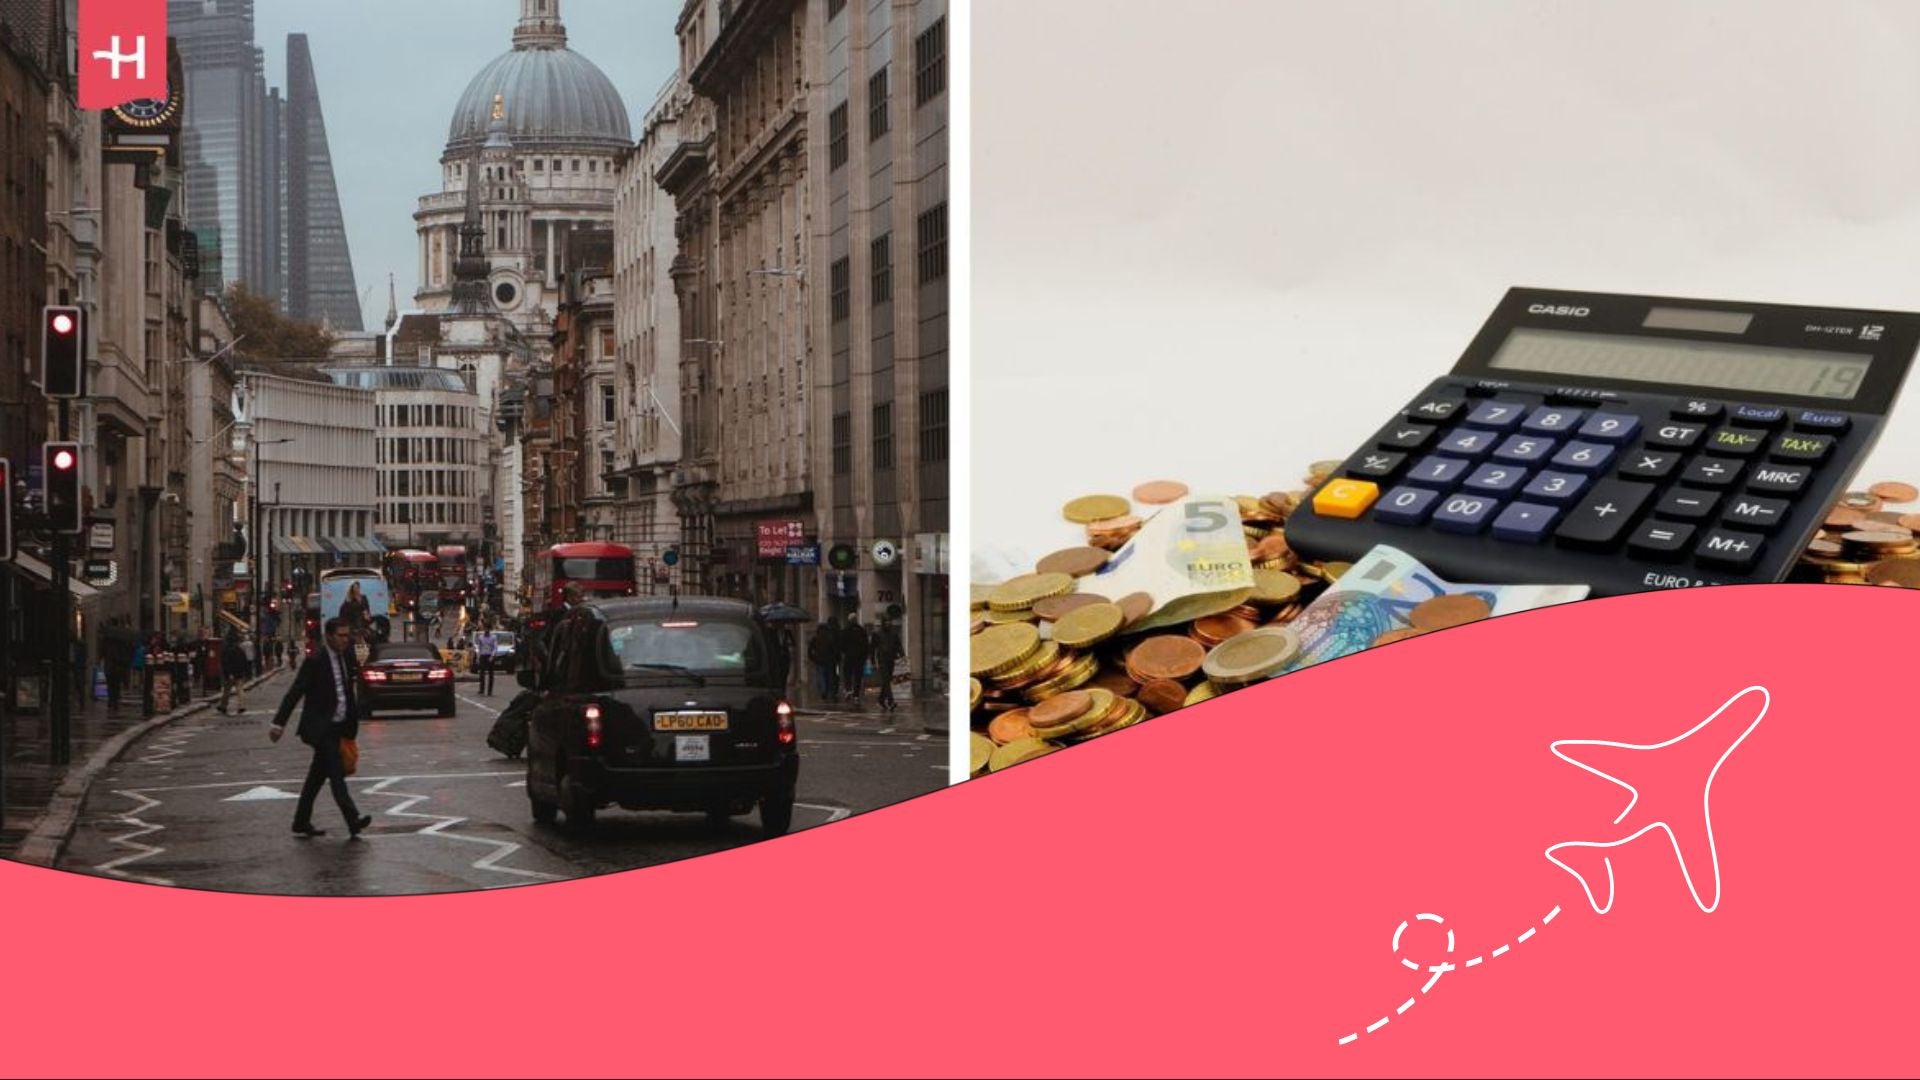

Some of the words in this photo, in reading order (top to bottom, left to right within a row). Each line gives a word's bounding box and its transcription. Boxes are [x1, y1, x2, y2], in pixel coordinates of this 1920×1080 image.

[1528, 304, 1590, 317] CASIO
[1808, 366, 1863, 397] 19
[1419, 402, 1452, 414] AC
[1487, 407, 1507, 420] 7
[1687, 401, 1707, 413] %
[1737, 405, 1781, 419] Local
[1540, 413, 1562, 427] 8
[1800, 411, 1842, 424] Euro
[1600, 419, 1619, 432] 9
[1658, 426, 1695, 439] GT
[1456, 435, 1477, 449] 4
[1513, 441, 1536, 455] 5
[1780, 437, 1823, 451] TAX+
[1572, 448, 1591, 462] 6
[1431, 463, 1448, 477] 1
[1756, 469, 1801, 484] MRC
[1489, 470, 1507, 485] 2
[1332, 484, 1357, 499] C
[1543, 478, 1566, 492] 3
[1395, 492, 1416, 507] 0
[1447, 499, 1483, 515] 00
[1184, 501, 1229, 533] 5
[759, 525, 771, 535] To
[772, 525, 787, 536] Let
[1707, 536, 1750, 552] M+
[1187, 562, 1243, 572] EURO
[1643, 572, 1689, 589] EURO
[877, 590, 893, 603] 70
[661, 715, 694, 728] LP60
